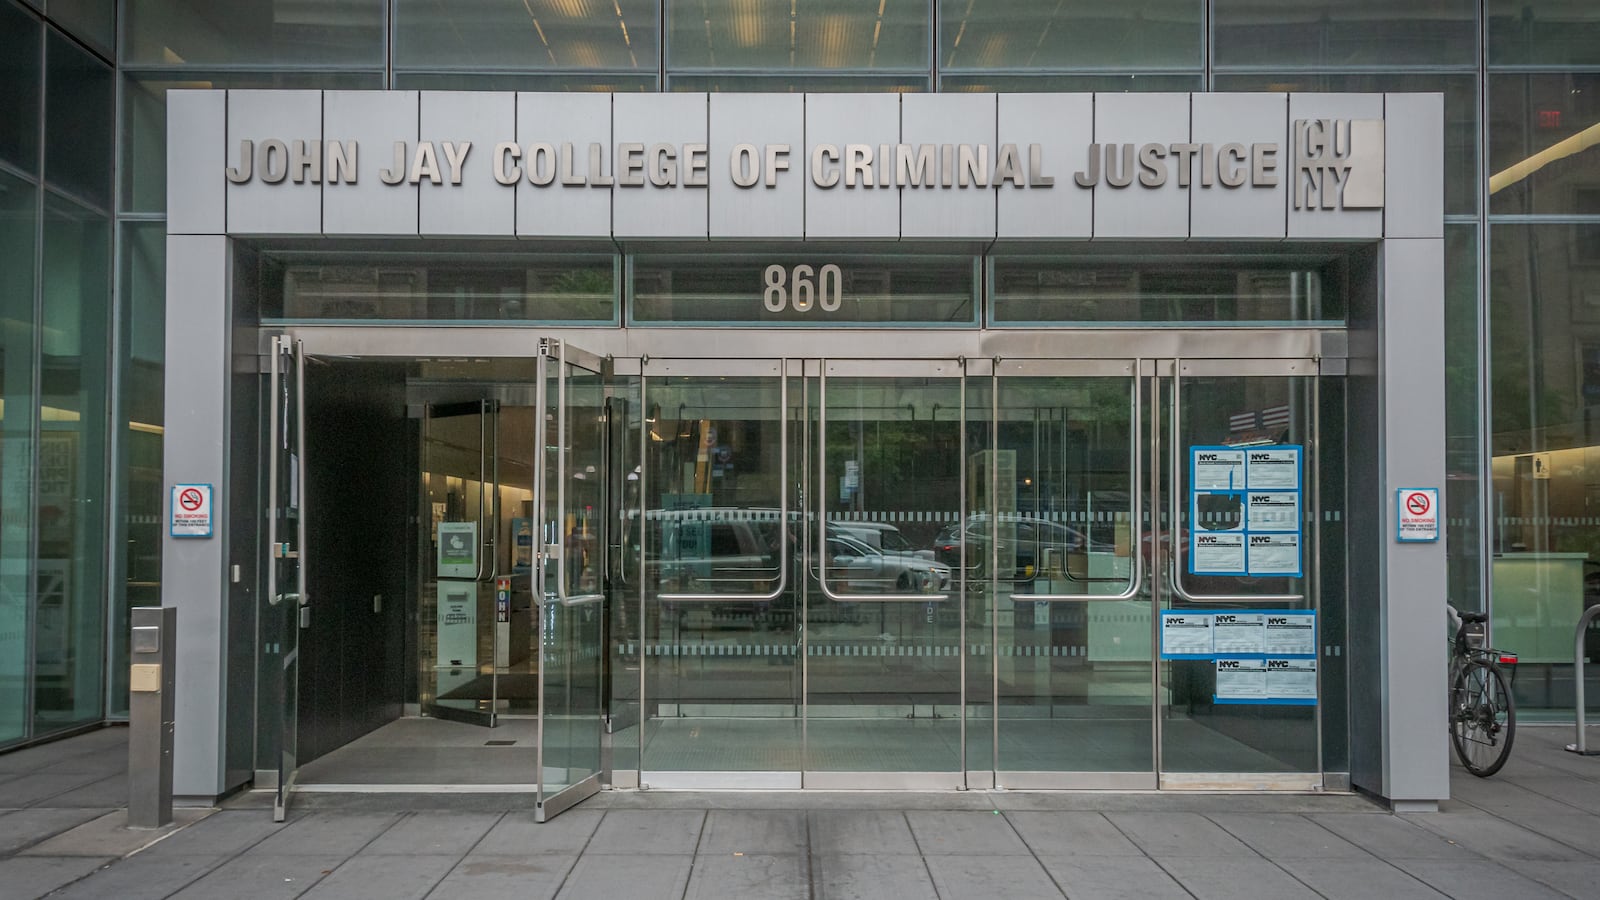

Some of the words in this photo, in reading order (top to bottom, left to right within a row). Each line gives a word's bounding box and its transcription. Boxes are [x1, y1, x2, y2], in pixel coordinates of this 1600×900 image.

[225, 138, 358, 186] JOHN
[378, 139, 472, 186] JAY
[492, 141, 709, 188] COLLEGE
[729, 142, 791, 189] OF
[811, 142, 1055, 189] CRIMINAL
[1074, 142, 1279, 189] JUSTICE
[763, 263, 843, 313] 860
[1215, 615, 1236, 623] NYC
[1268, 660, 1289, 668] NYC
